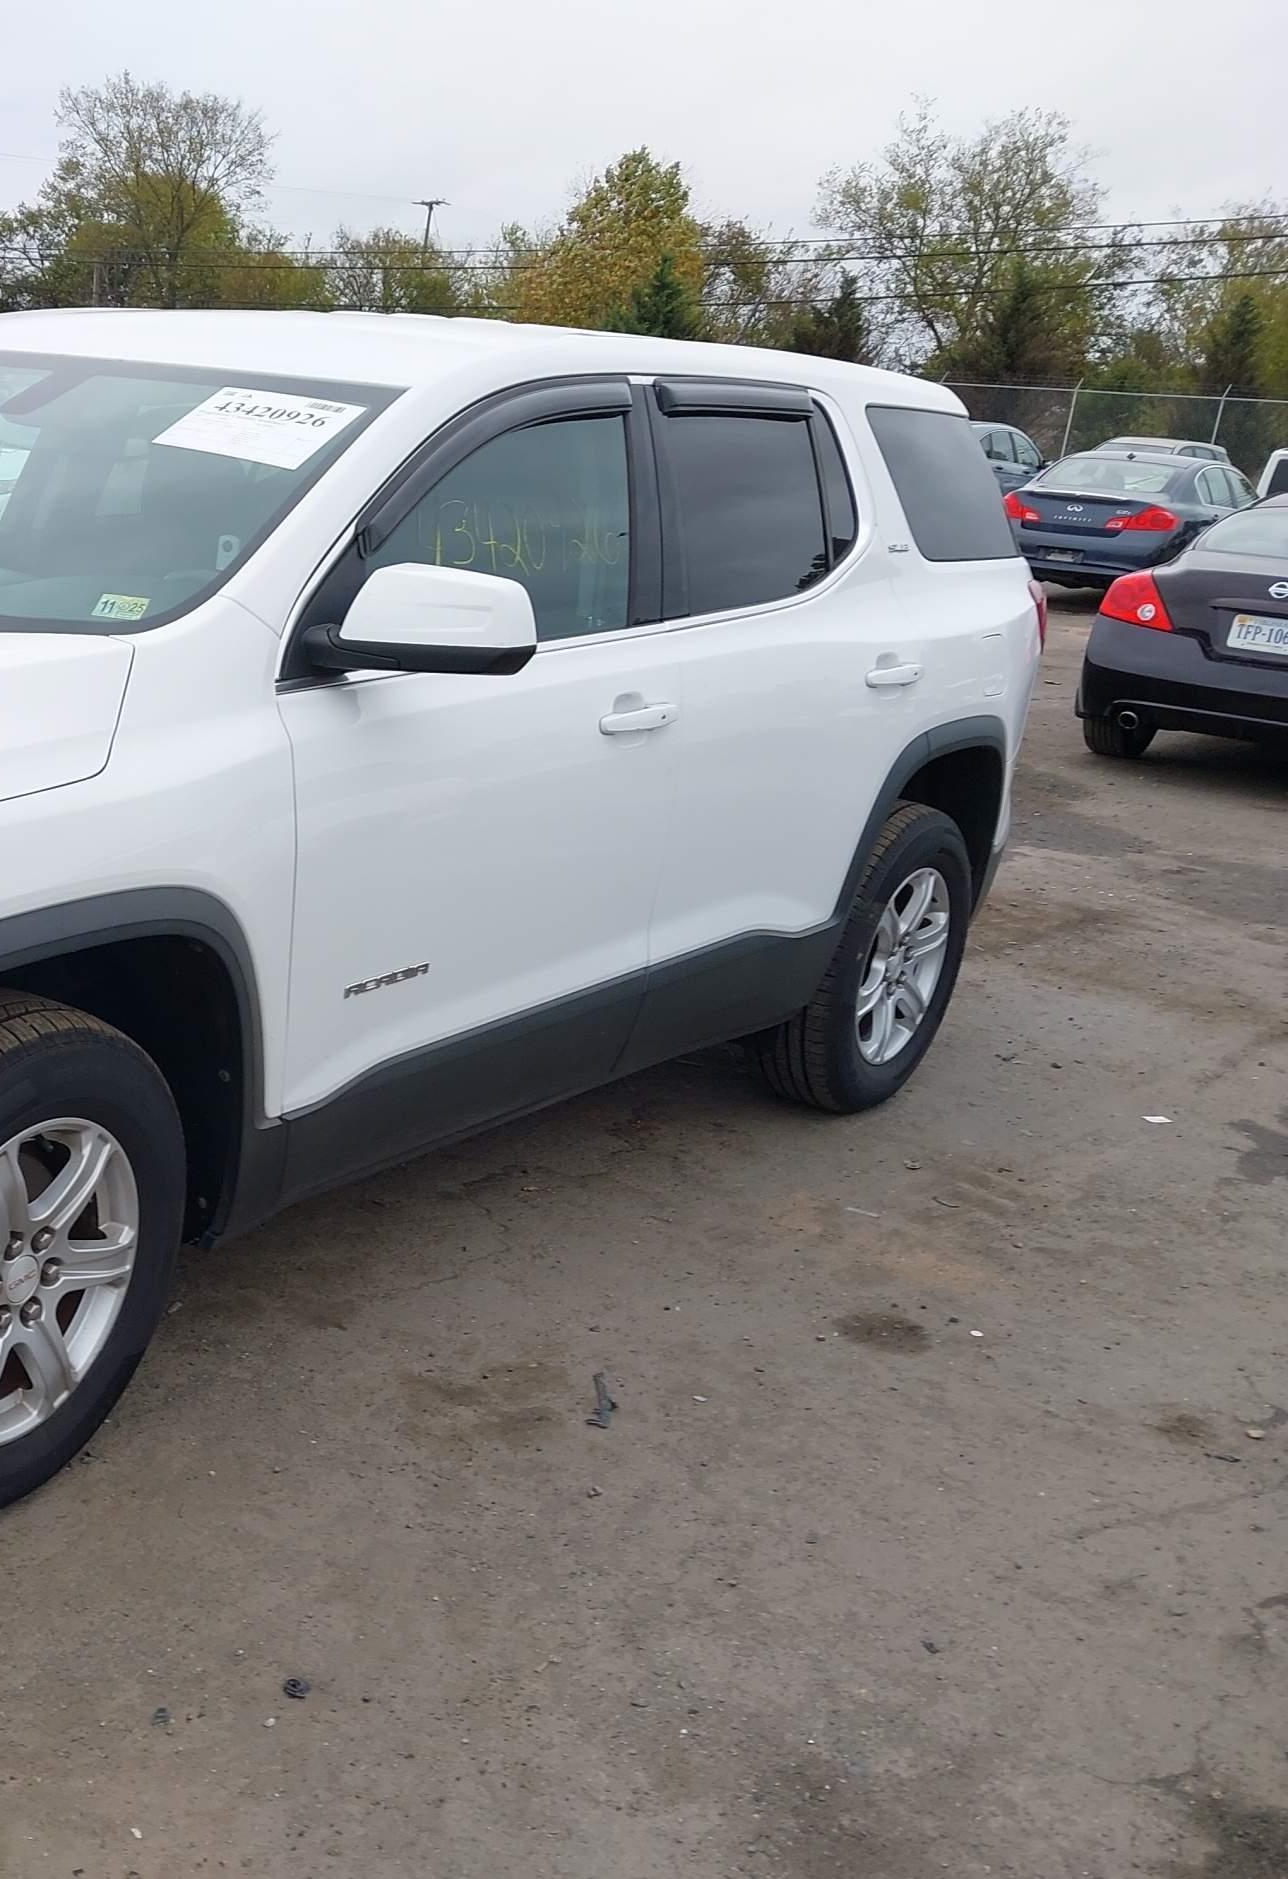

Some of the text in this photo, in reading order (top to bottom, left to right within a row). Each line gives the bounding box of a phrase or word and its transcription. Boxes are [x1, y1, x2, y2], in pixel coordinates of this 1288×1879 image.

[214, 401, 331, 428] 43420926
[101, 600, 116, 613] 11
[343, 961, 430, 999] ACADIA
